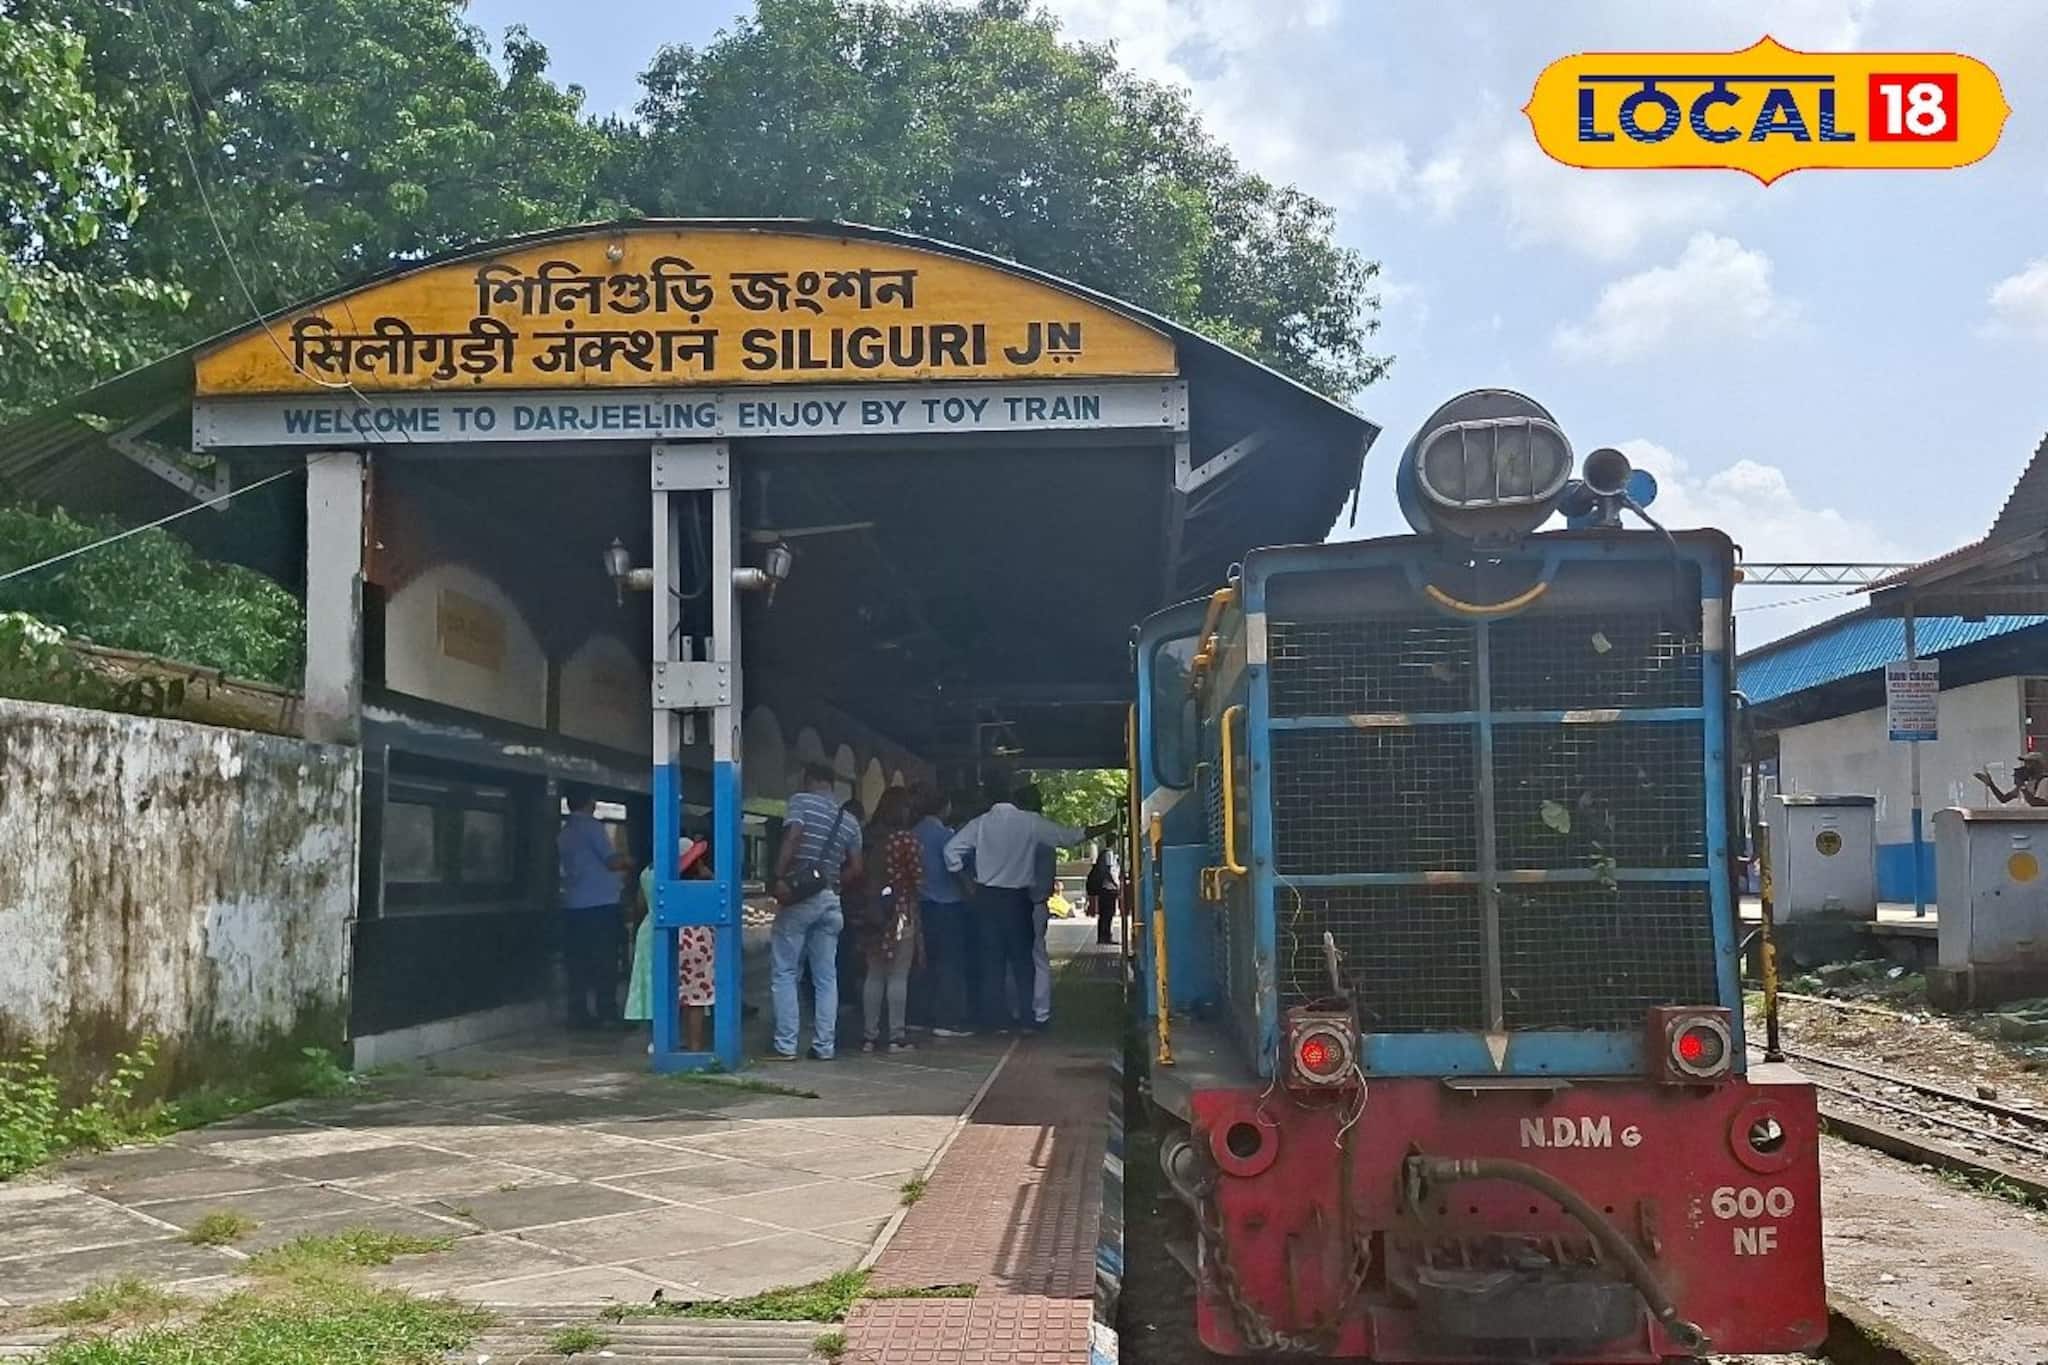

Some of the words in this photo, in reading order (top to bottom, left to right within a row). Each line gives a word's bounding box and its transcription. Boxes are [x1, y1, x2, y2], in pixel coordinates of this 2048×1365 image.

[474, 256, 714, 324] শিলিগুড়ি
[729, 268, 918, 316] জংশন
[289, 316, 519, 385] सिलीगुड़ी
[532, 319, 719, 373] जंक्शन
[742, 324, 986, 371] SILIGURI
[284, 407, 441, 436] WELCOME
[453, 407, 497, 433] TO
[514, 401, 718, 432] DARJEELING
[738, 400, 848, 427] ENJOY
[861, 400, 907, 425] BY
[921, 398, 990, 423] TOY
[1004, 395, 1101, 421] TRAIN
[1520, 1115, 1613, 1148] N.D.M
[1711, 1186, 1795, 1219] 600
[1733, 1226, 1778, 1255] NF
